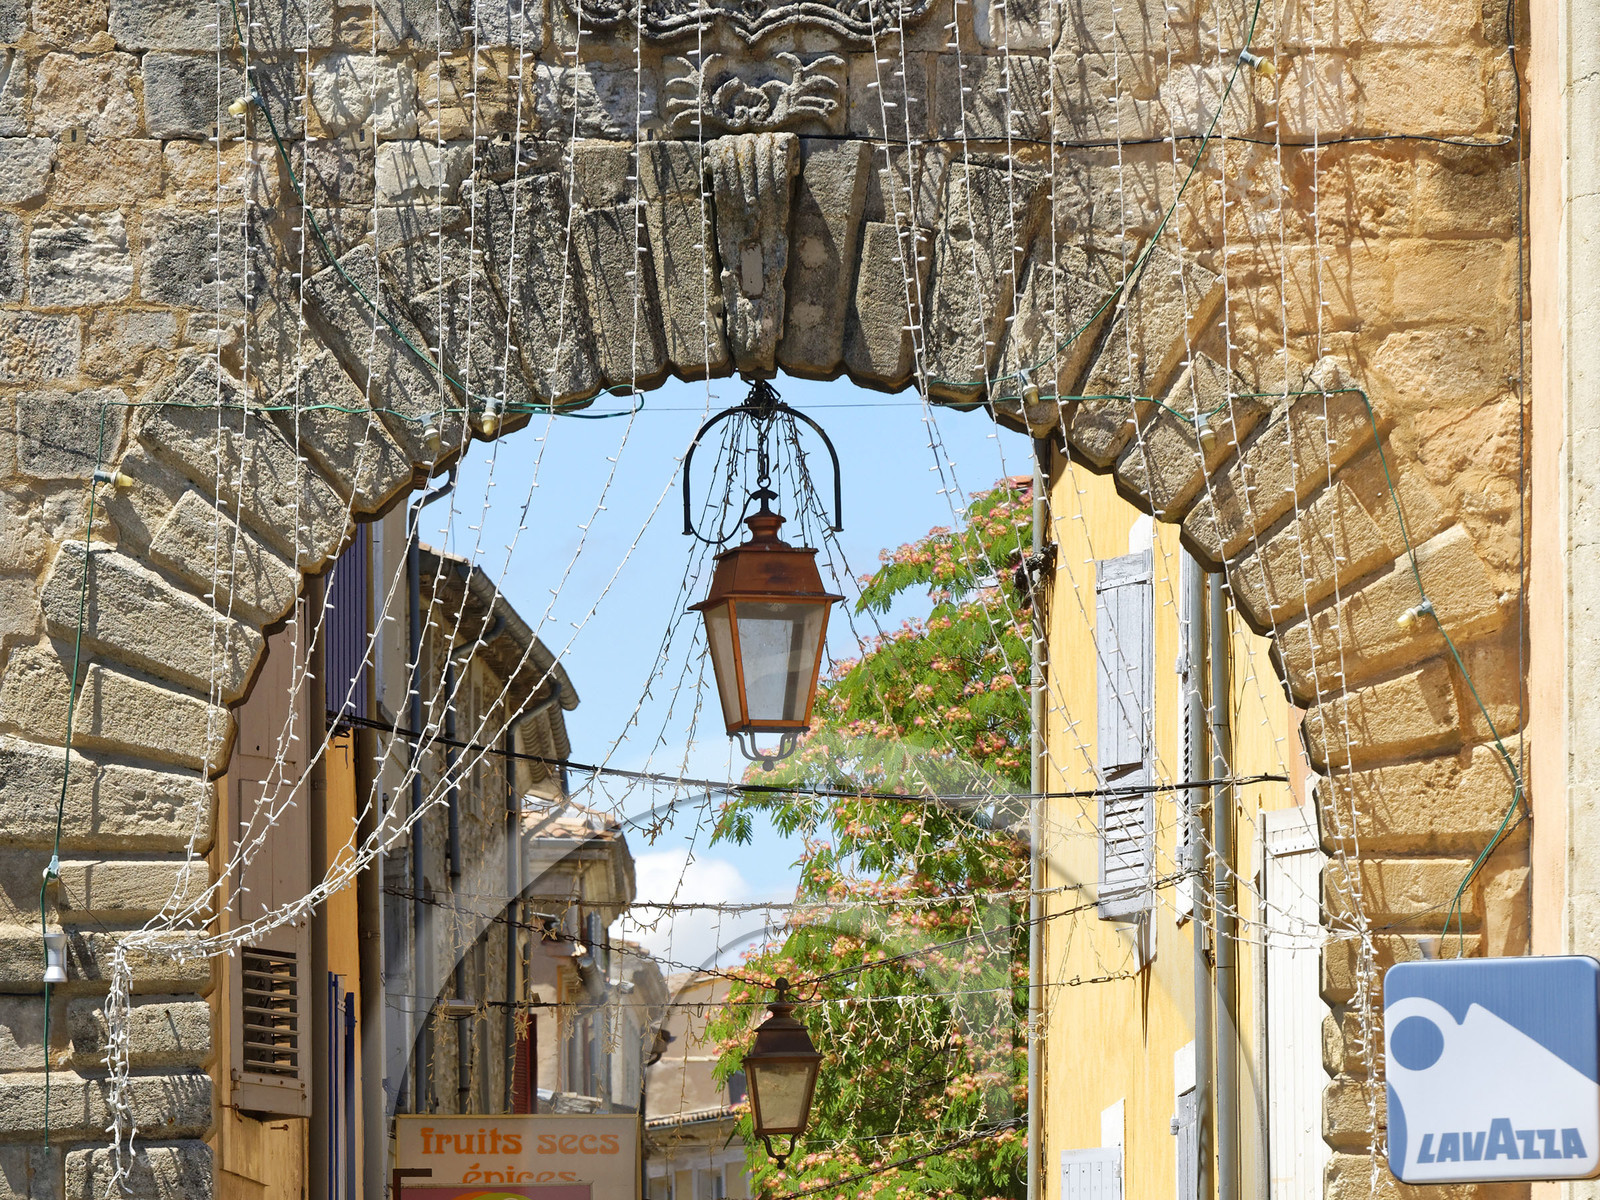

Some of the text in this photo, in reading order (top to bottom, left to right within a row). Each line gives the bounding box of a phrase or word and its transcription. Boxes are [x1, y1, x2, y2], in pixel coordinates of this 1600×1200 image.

[420, 1127, 620, 1155] fruits secs
[1416, 1117, 1588, 1164] LAVAZZA
